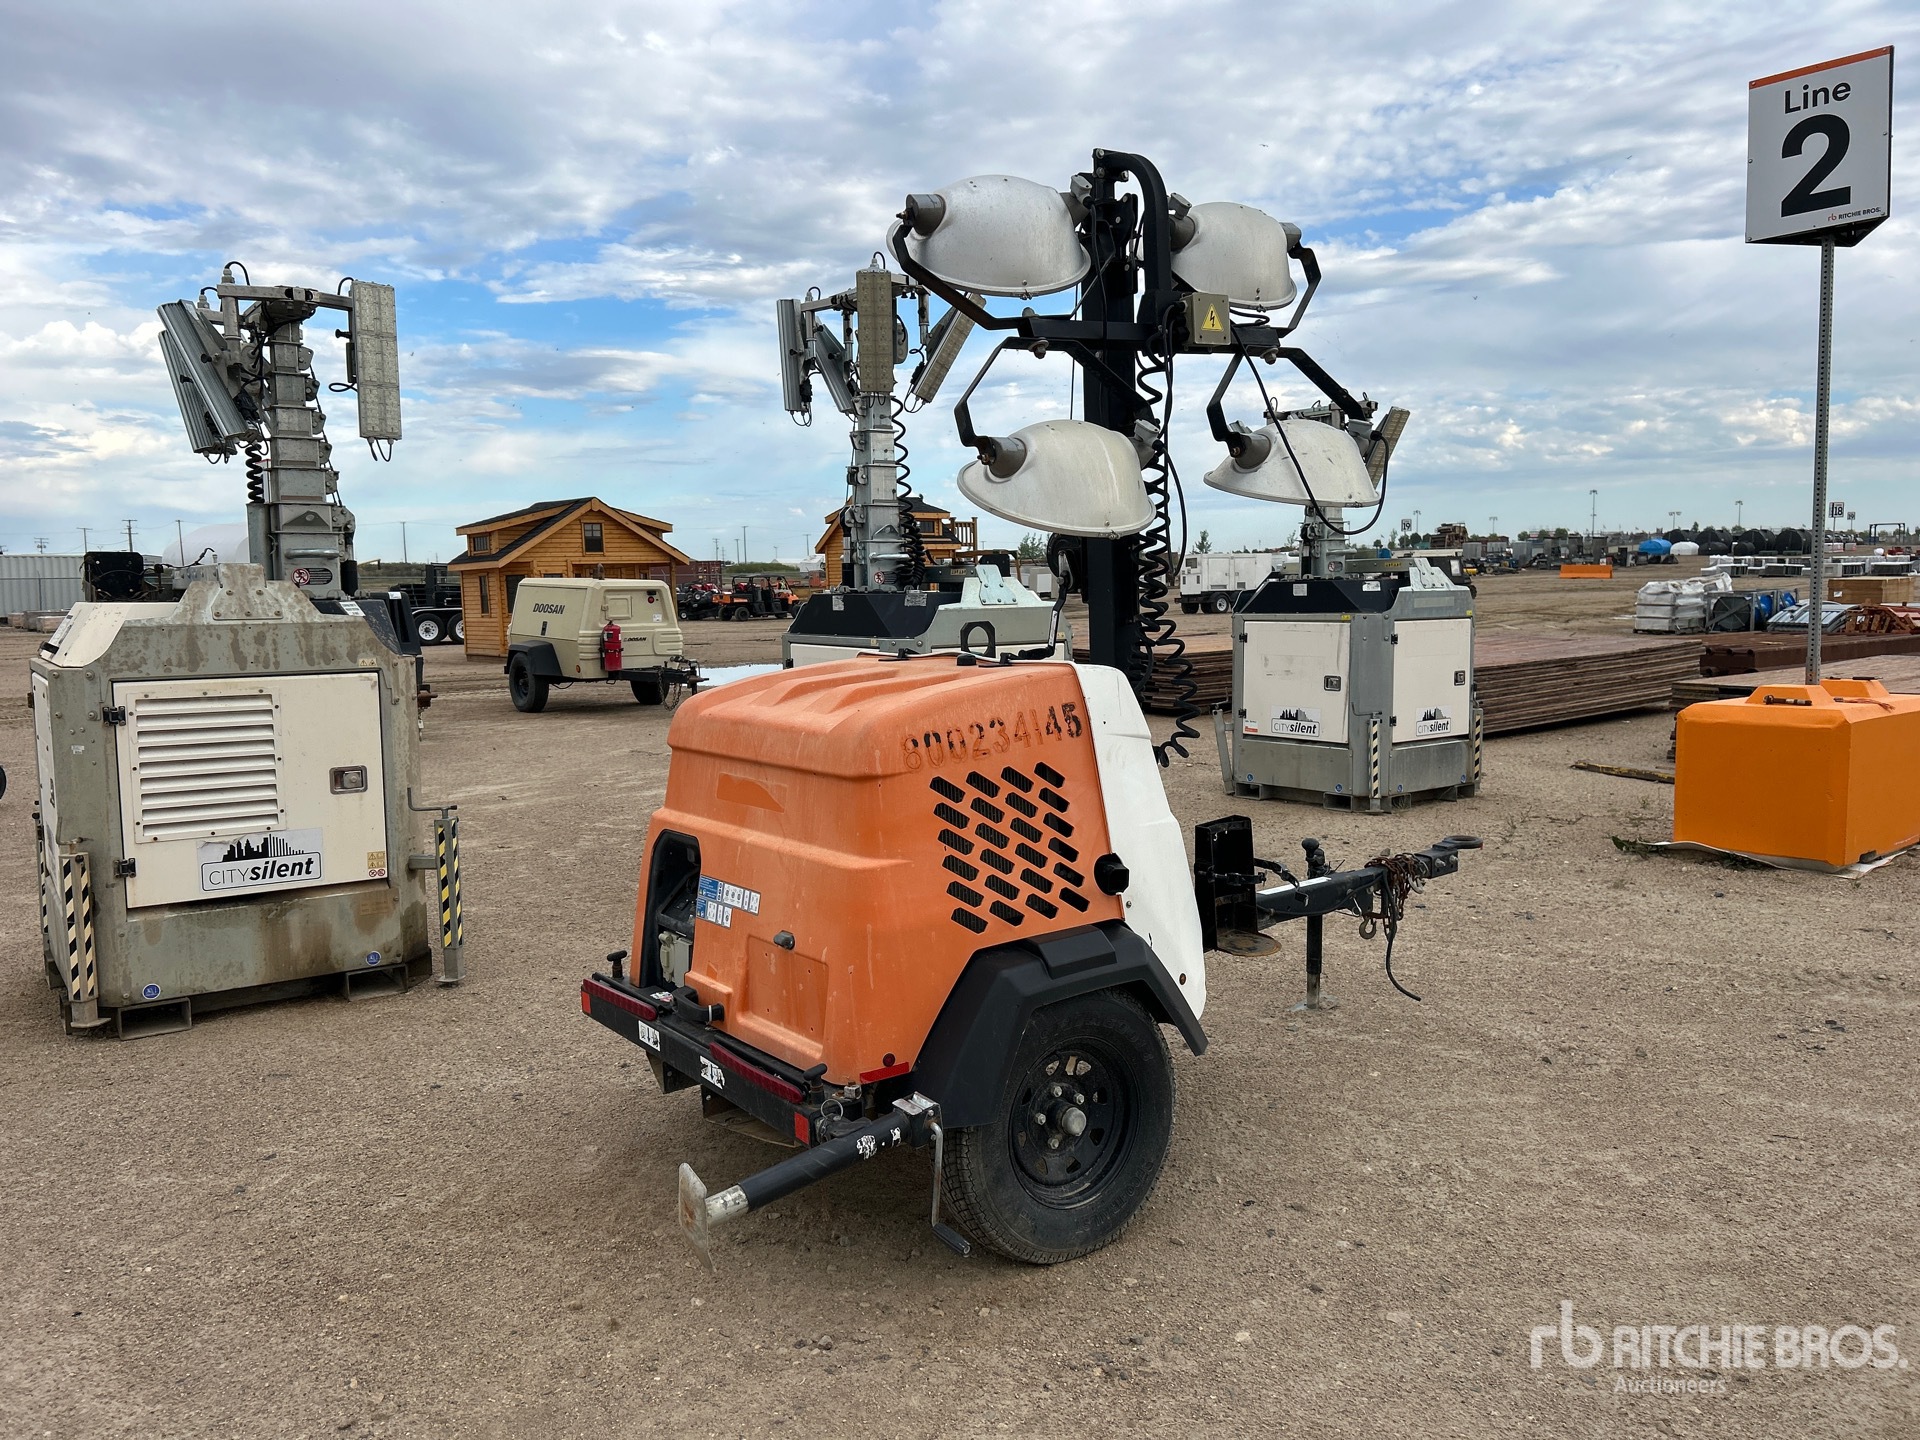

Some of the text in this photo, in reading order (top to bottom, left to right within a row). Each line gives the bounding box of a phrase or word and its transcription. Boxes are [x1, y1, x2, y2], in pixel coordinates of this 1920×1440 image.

[1784, 82, 1852, 114] Line
[1780, 113, 1852, 218] 2
[1838, 210, 1862, 220] RITCHIE
[1862, 206, 1881, 215] BROS.
[1834, 506, 1843, 516] 18
[1403, 522, 1411, 531] 19
[532, 603, 566, 615] DOOSAN
